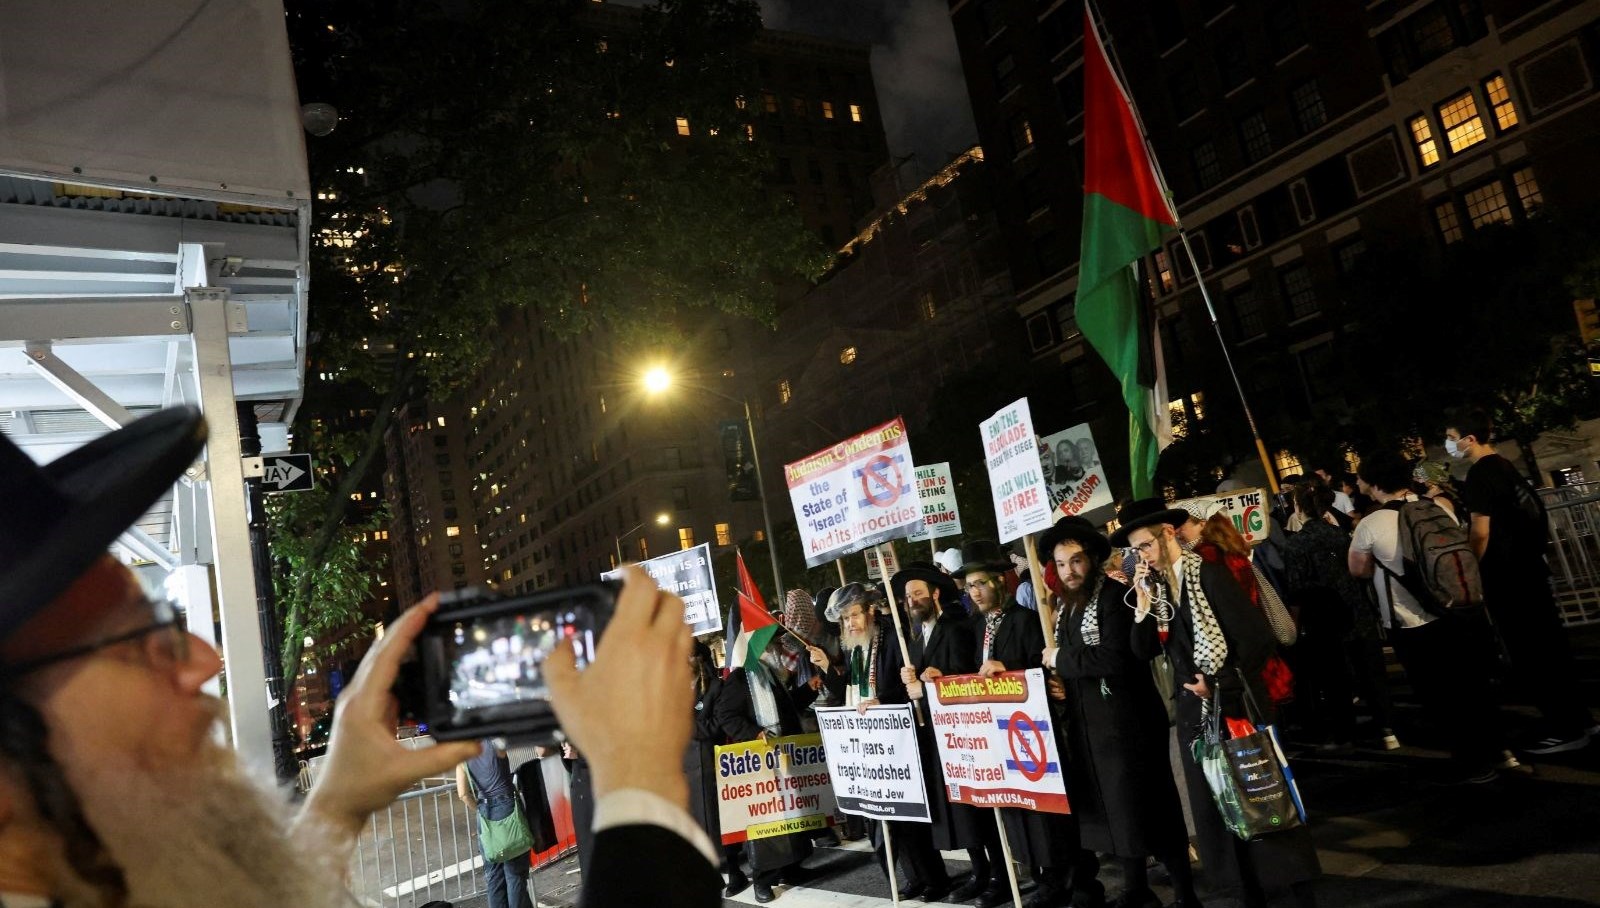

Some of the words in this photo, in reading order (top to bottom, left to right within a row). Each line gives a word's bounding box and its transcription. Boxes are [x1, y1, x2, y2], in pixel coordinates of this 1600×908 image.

[1001, 410, 1019, 429] THE
[789, 454, 832, 482] Judaism
[834, 425, 902, 460] Condemns
[1014, 439, 1033, 456] SIEGE
[810, 480, 830, 497] the
[924, 478, 935, 487] UN
[939, 476, 946, 485] IS
[1014, 469, 1039, 489] WILL
[802, 498, 832, 518] State
[836, 489, 848, 504] of
[1002, 498, 1014, 517] BE
[1014, 487, 1039, 511] FREE
[1060, 474, 1101, 517] Fascism
[1238, 493, 1260, 507] THE
[938, 503, 946, 512] IS
[811, 535, 834, 553] And
[836, 529, 851, 546] its
[680, 559, 691, 571] is
[697, 556, 705, 566] a
[939, 679, 986, 698] Authentic
[985, 677, 1024, 695] Rabbis
[822, 714, 845, 730] Israel
[845, 715, 855, 730] is
[856, 714, 911, 734] responsible
[933, 710, 960, 728] always
[850, 738, 860, 754] 77
[862, 742, 885, 758] years
[887, 745, 895, 755] of
[944, 733, 989, 750] Zionism
[720, 750, 761, 777] State
[766, 744, 780, 770] of
[838, 762, 861, 781] tragic
[862, 763, 911, 780] bloodshed
[946, 762, 967, 779] State
[972, 763, 1005, 781] Israel
[722, 782, 752, 801] does
[756, 776, 782, 795] not
[848, 785, 855, 794] of
[870, 789, 882, 799] and
[885, 788, 904, 799] Jew
[748, 795, 787, 817] world
[789, 793, 820, 811] Jewry
[756, 819, 823, 836] www.NKUSA.org
